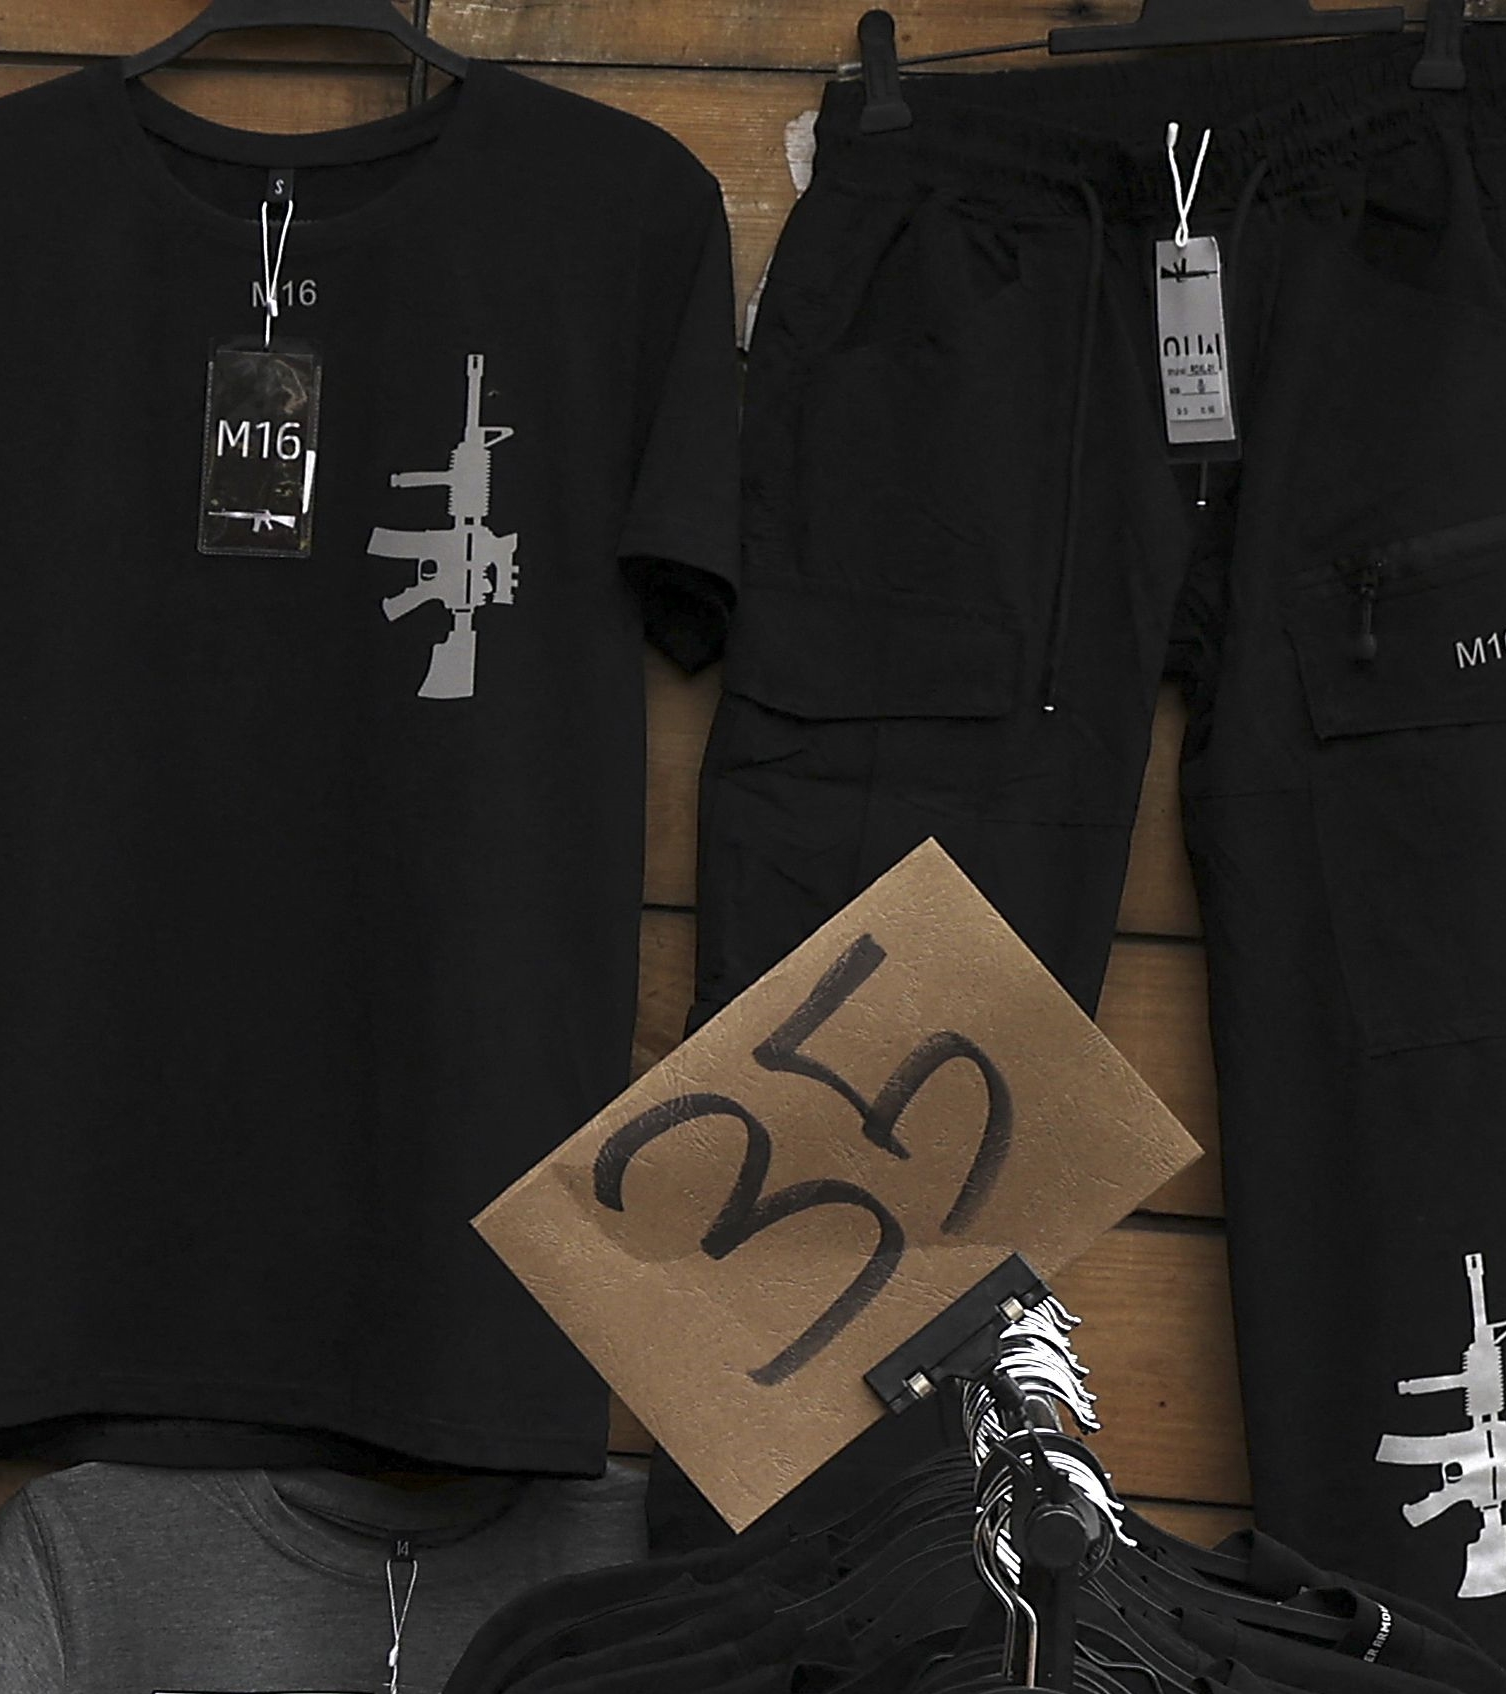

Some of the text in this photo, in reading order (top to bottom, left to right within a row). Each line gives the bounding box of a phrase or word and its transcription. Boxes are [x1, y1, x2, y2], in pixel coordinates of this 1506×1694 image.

[274, 178, 285, 195] S
[217, 419, 301, 460] M16
[1455, 630, 1506, 669] M1
[593, 933, 1013, 1388] 35
